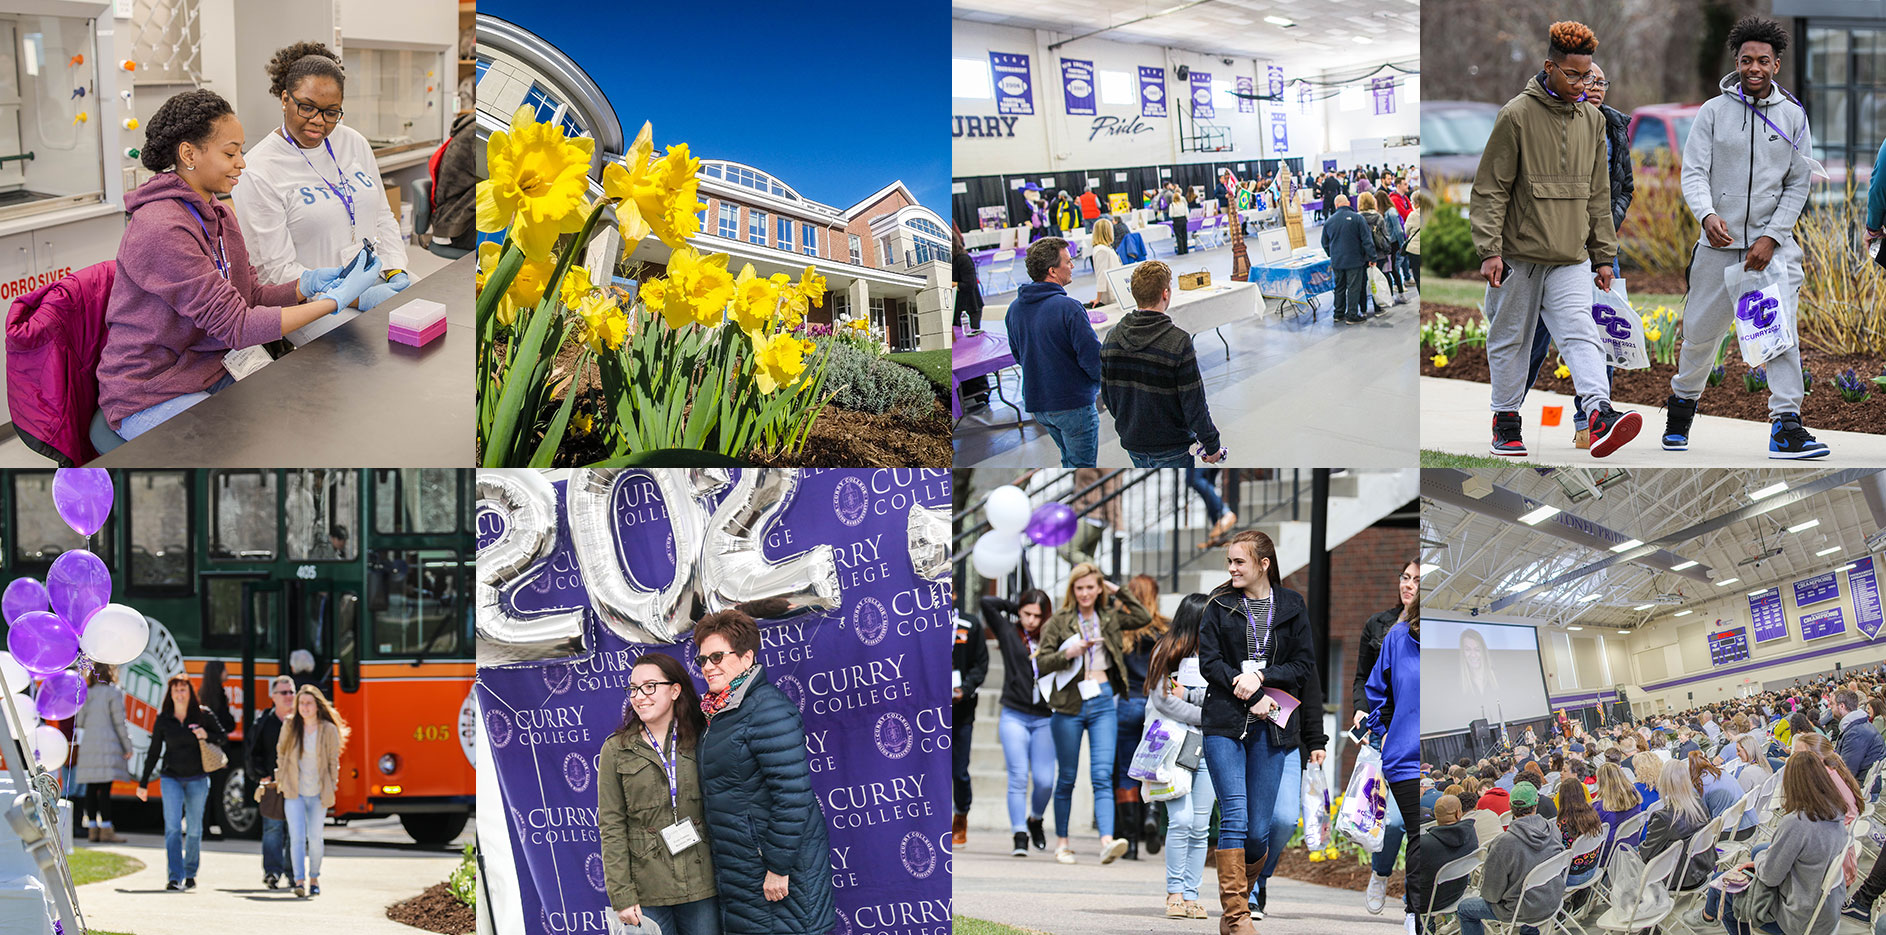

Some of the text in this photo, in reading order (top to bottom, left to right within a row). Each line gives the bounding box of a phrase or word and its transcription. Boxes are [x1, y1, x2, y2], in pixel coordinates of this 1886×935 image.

[1089, 115, 1154, 141] Pride
[875, 481, 951, 515] COLLE
[625, 505, 668, 526] OLLE
[834, 534, 883, 568] RRY
[476, 467, 951, 667] 202
[841, 562, 890, 590] LEGE
[1797, 575, 1833, 590] CHAMPIONS
[1803, 610, 1839, 624] CHAMPIONS
[759, 622, 805, 650] RRY
[765, 645, 813, 667] LEGE
[578, 674, 631, 691] COLLE
[808, 653, 905, 696] CURRY
[813, 681, 912, 715] COLLEGE
[516, 705, 584, 729] CURRY
[413, 725, 450, 742] 405
[519, 728, 590, 745] COLLEGE
[828, 773, 926, 811] CURRY
[528, 806, 599, 829] CURRY
[832, 801, 933, 829] COLLEGE
[531, 829, 598, 845] COLLEG
[855, 898, 952, 929] CURRY
